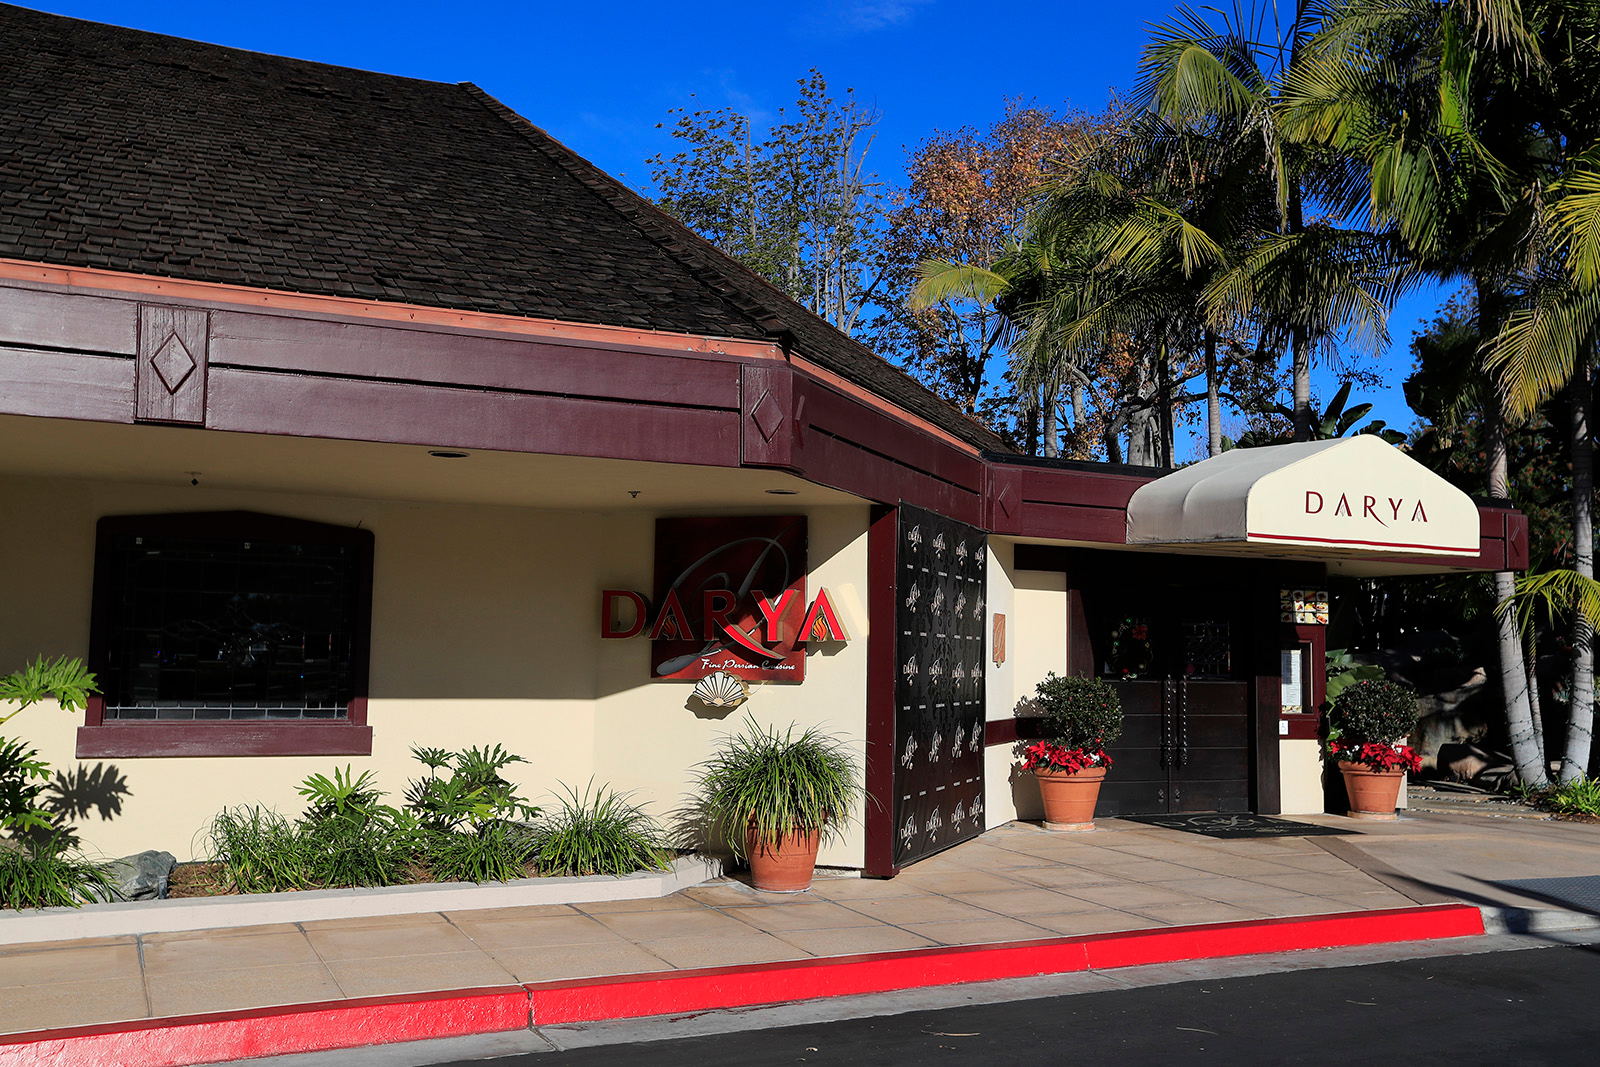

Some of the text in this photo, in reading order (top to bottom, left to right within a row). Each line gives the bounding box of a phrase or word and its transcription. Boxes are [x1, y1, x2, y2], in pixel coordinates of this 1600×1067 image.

[1305, 490, 1428, 528] DARYA
[601, 586, 848, 660] DARYA
[701, 658, 796, 671] Fine Persian Cuisine
